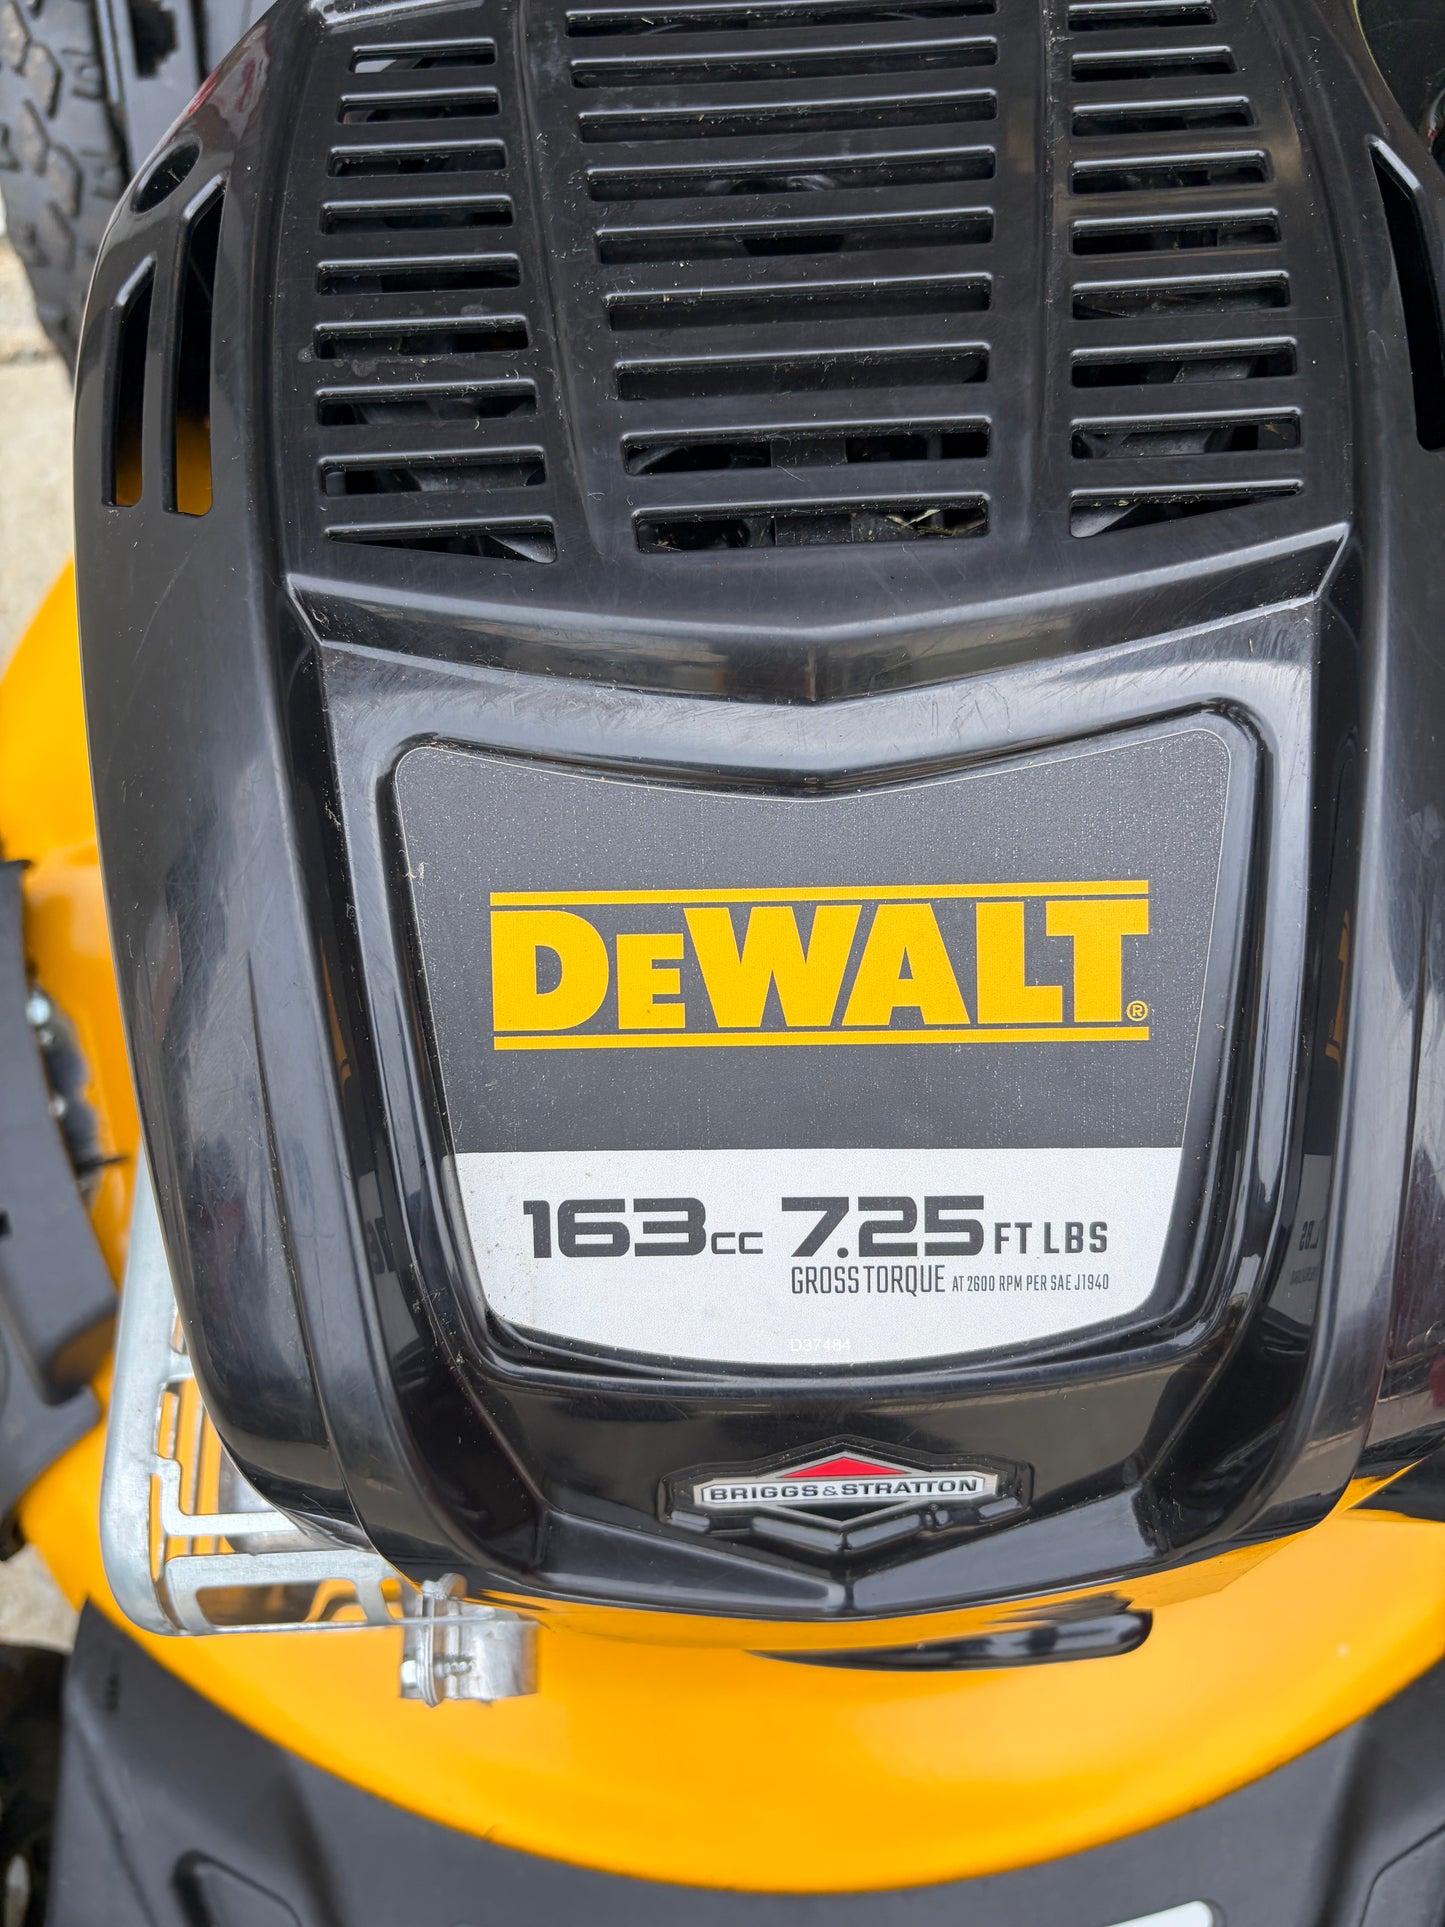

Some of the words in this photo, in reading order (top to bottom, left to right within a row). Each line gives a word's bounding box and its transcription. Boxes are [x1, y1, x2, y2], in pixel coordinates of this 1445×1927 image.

[781, 1195, 984, 1257] 7.25
[994, 1222, 1033, 1254] FT
[1044, 1221, 1108, 1254] LBS
[791, 1266, 859, 1294] GROSS
[863, 1265, 945, 1297] TORQUE
[952, 1275, 964, 1292] AT
[967, 1275, 995, 1292] 2600
[999, 1275, 1022, 1292] RPM
[1026, 1275, 1047, 1291] PER
[1050, 1274, 1071, 1291] SAE
[1074, 1274, 1109, 1290] J1940
[790, 1338, 852, 1351] D37484
